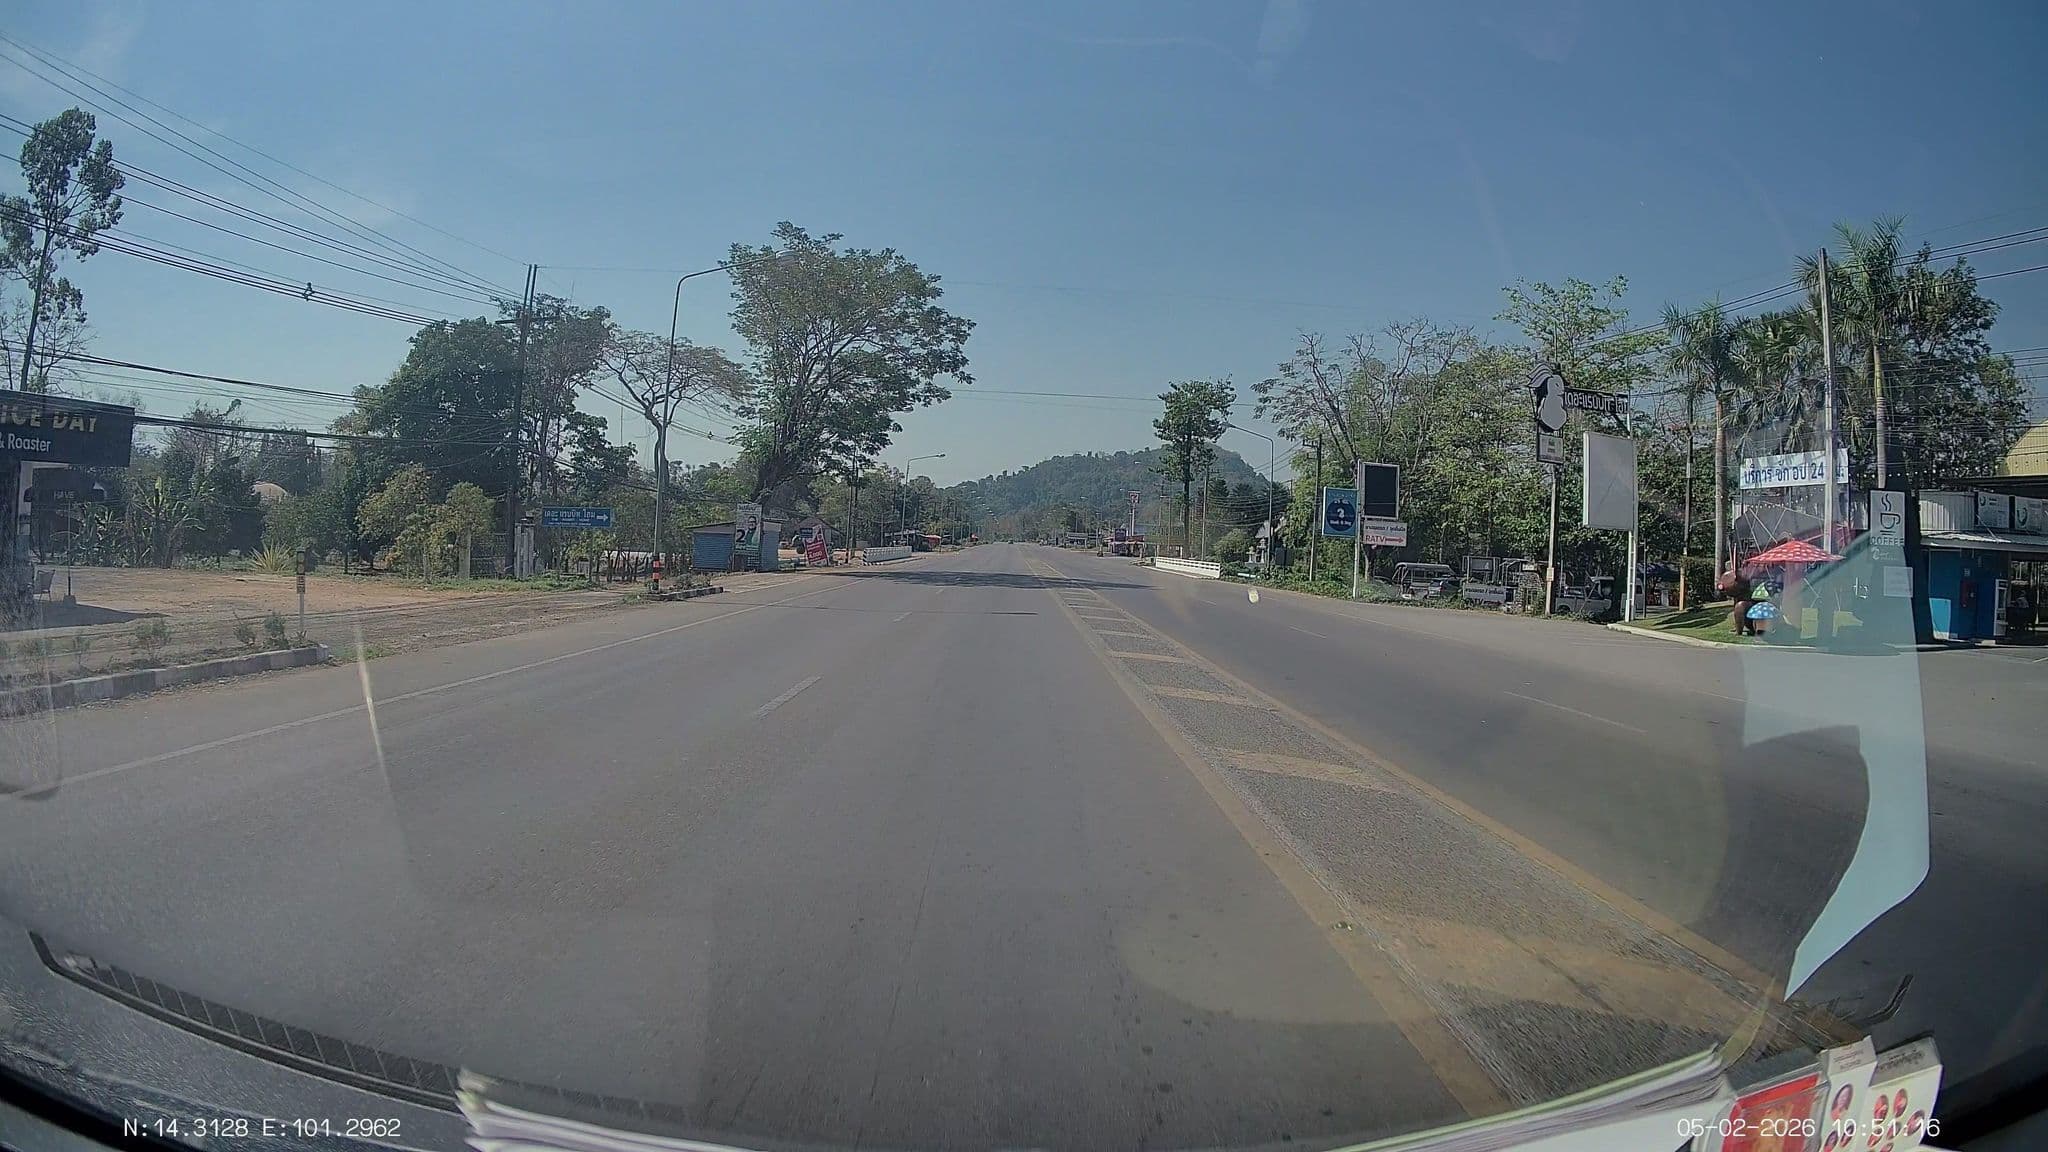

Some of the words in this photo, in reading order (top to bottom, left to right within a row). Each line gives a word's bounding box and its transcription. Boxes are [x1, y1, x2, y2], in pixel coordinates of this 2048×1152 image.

[52, 411, 97, 432] DAY
[8, 433, 51, 452] Roaster
[1810, 462, 1824, 480] 24
[735, 528, 746, 543] 2
[1870, 536, 1905, 547] COFFEE
